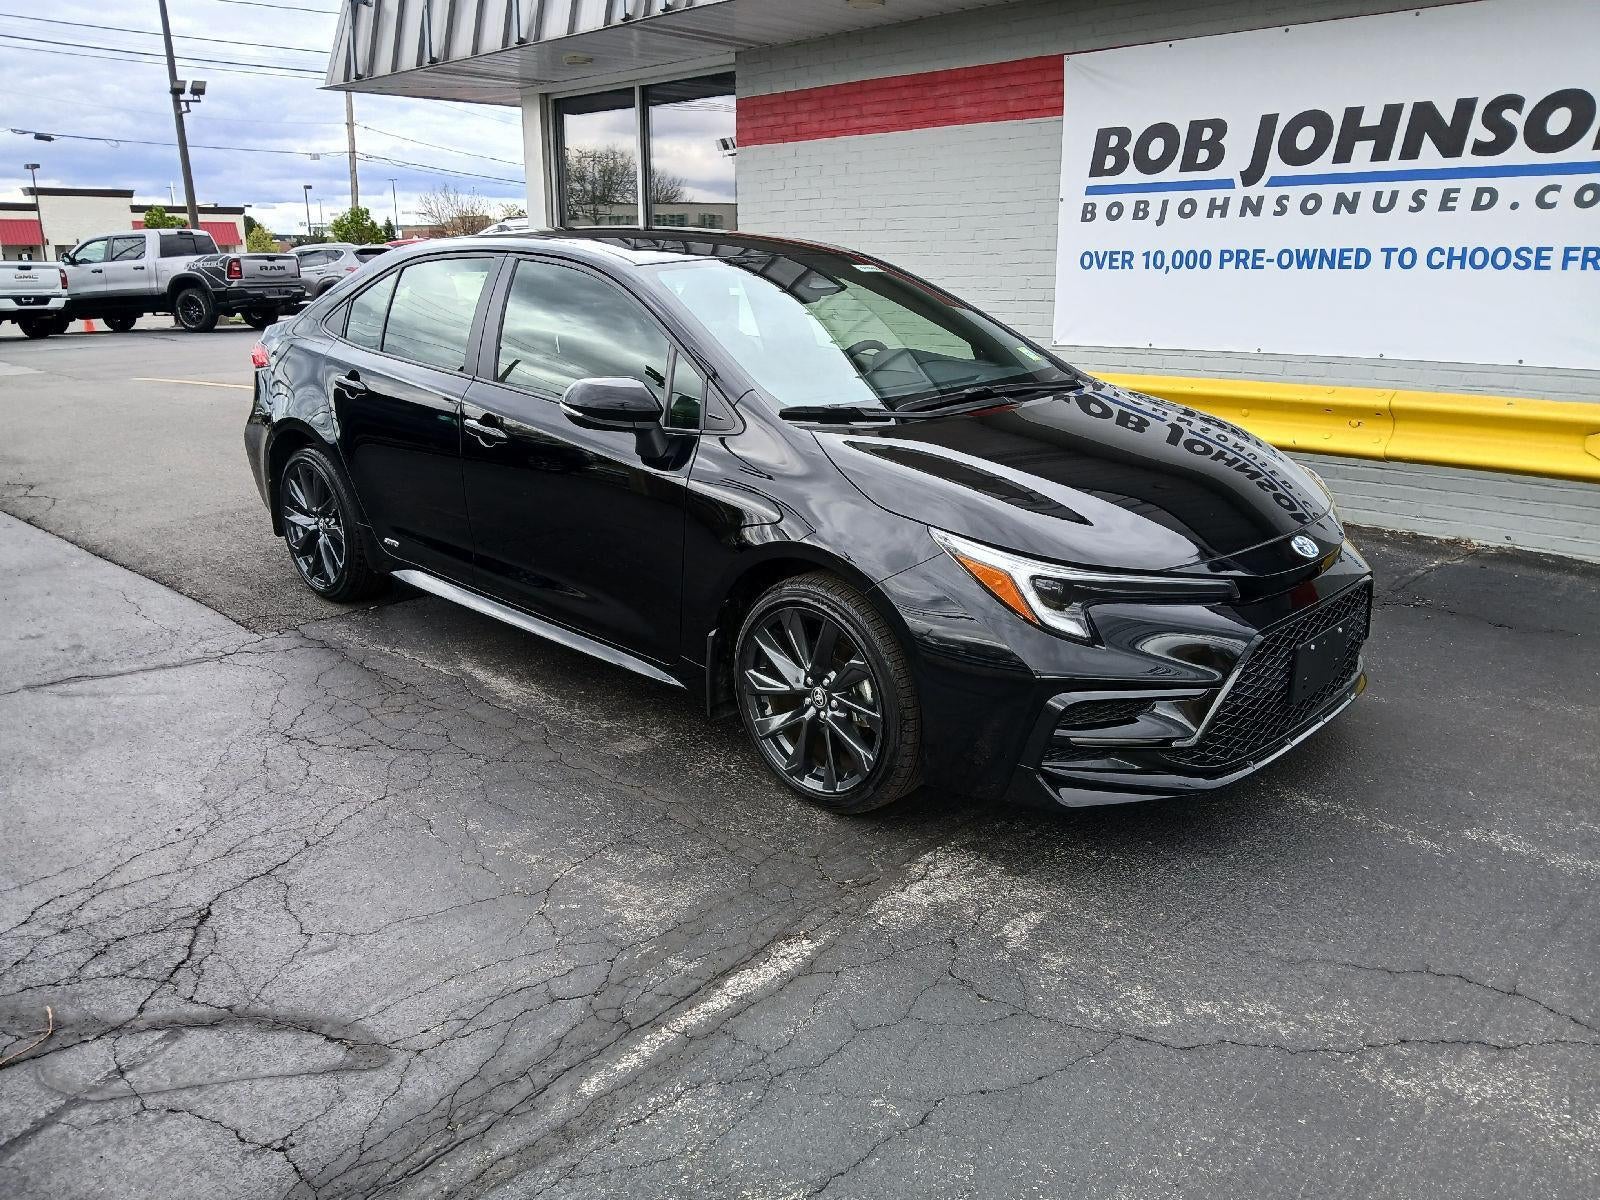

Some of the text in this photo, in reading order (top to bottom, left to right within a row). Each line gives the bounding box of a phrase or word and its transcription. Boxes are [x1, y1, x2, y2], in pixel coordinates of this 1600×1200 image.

[1088, 88, 1600, 188] BOB JOHNSO
[1079, 249, 1135, 270] OVER
[1141, 249, 1212, 274] 10,000
[1218, 247, 1372, 270] PRE-OWNED
[1380, 247, 1418, 270] TO
[1426, 246, 1554, 271] CHOOSE
